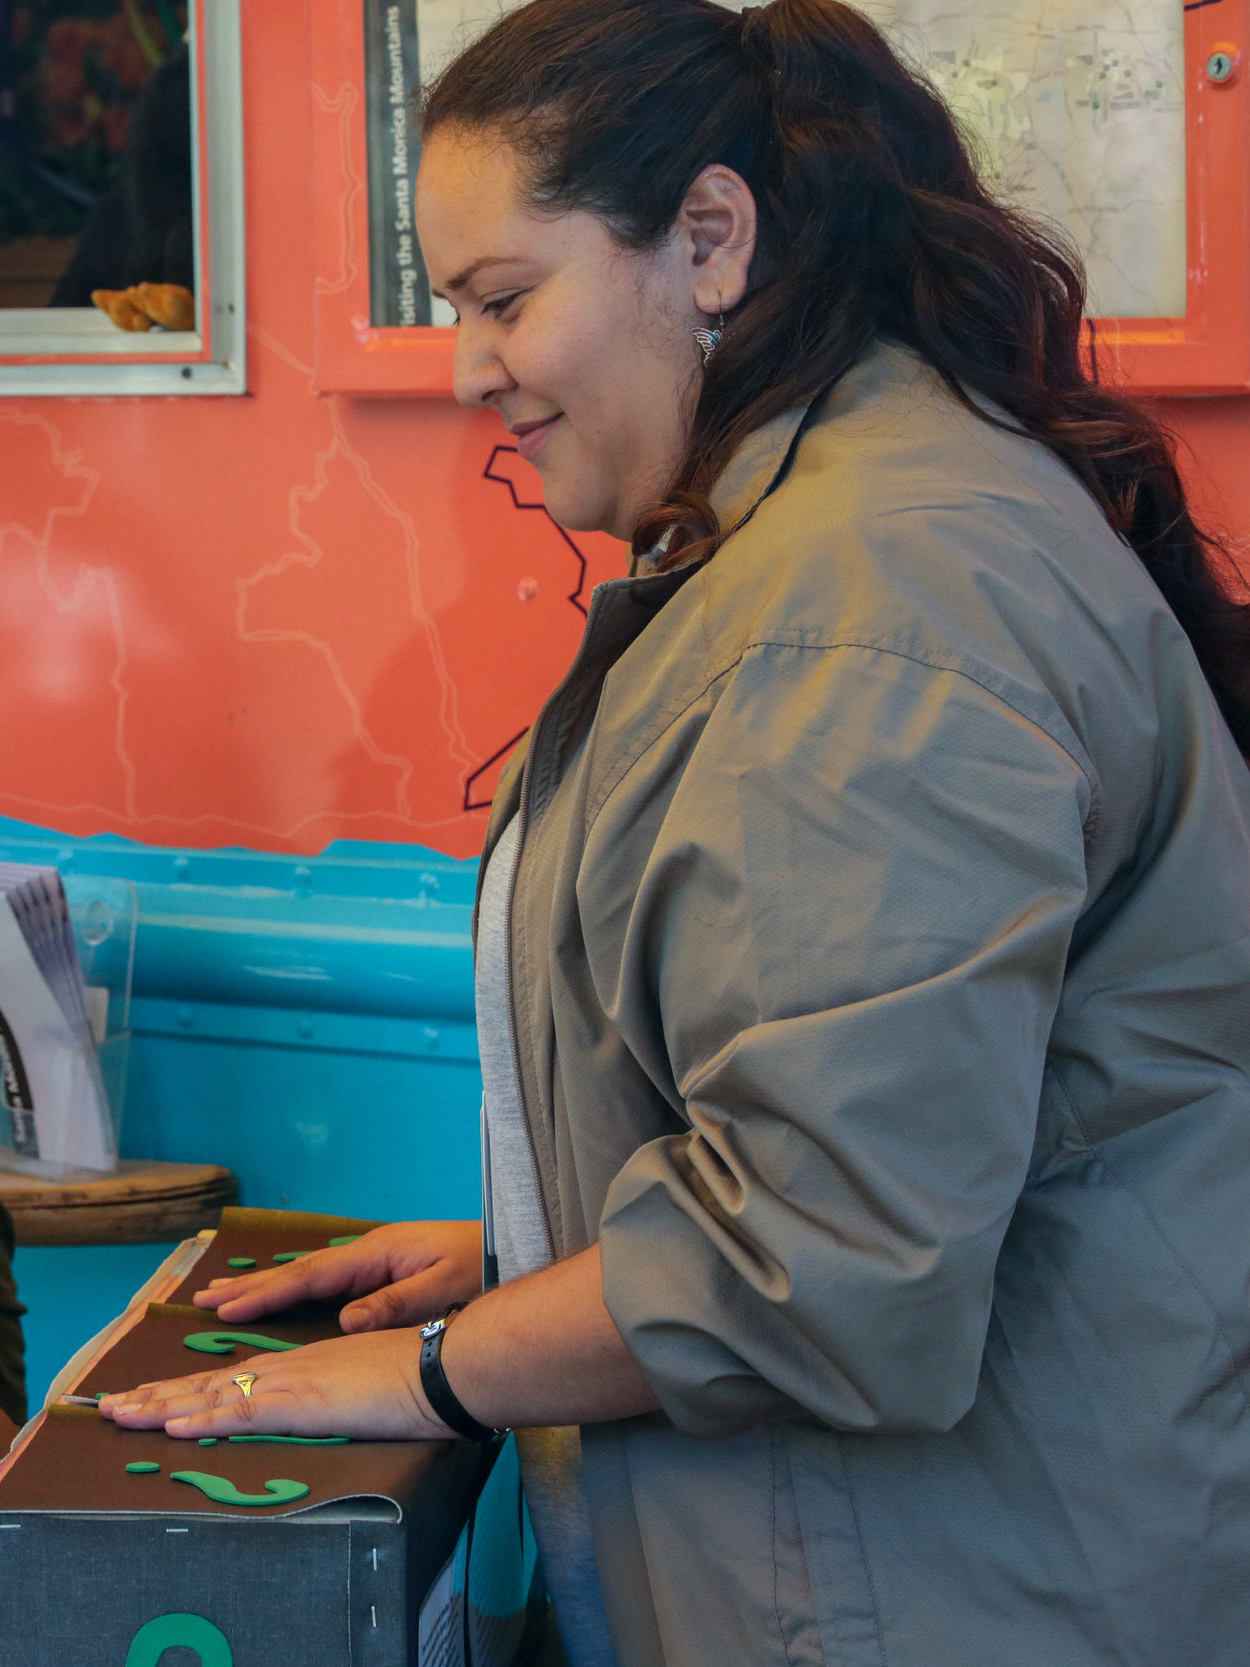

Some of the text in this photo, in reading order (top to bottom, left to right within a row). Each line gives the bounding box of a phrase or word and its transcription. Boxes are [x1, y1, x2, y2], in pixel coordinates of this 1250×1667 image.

[385, 5, 405, 104] Mountains
[390, 107, 408, 175] Monica
[394, 178, 411, 231] Santa
[396, 234, 413, 266] the
